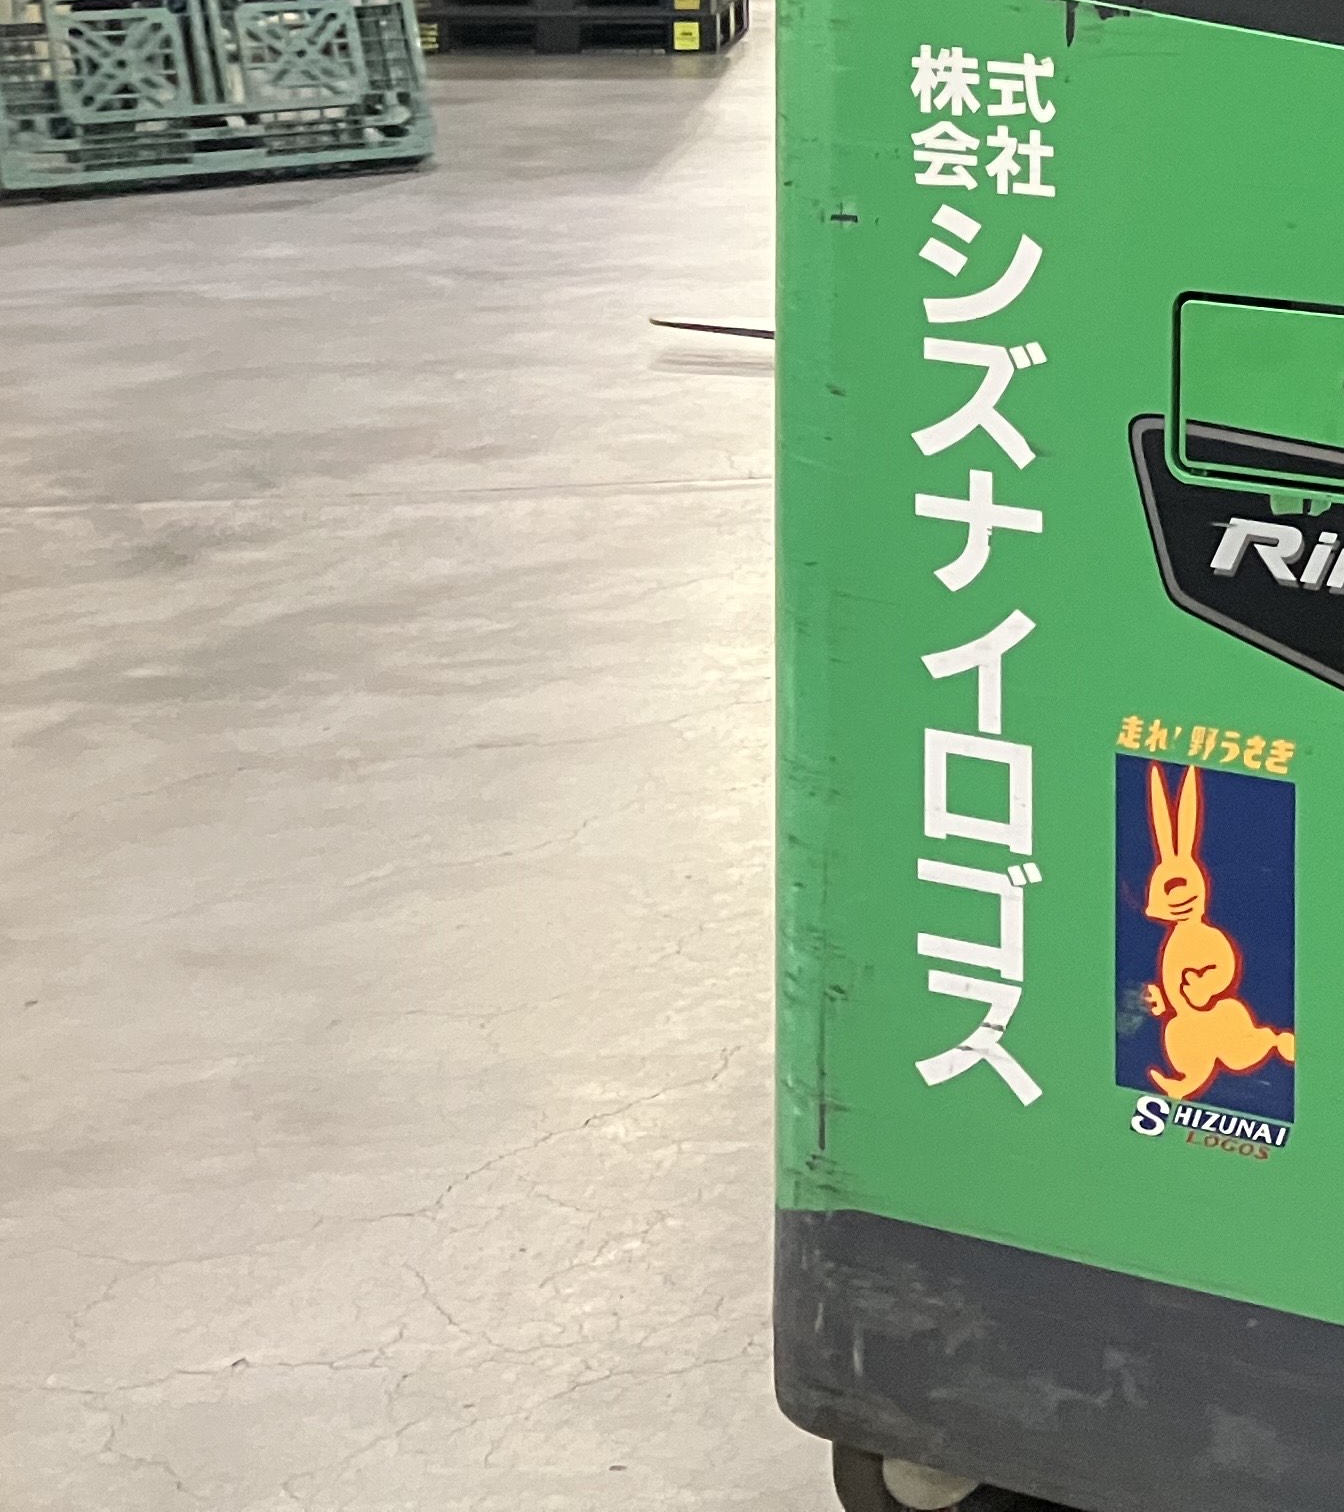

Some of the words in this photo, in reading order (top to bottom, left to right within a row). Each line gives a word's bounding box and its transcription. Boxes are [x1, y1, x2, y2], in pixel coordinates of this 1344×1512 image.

[910, 44, 1057, 125] 株式
[910, 120, 1057, 198] 会社
[910, 203, 1048, 1107] シズナイロゴス
[1131, 1095, 1287, 1146] SHIZUNAI
[1185, 1130, 1270, 1160] LOGOS
